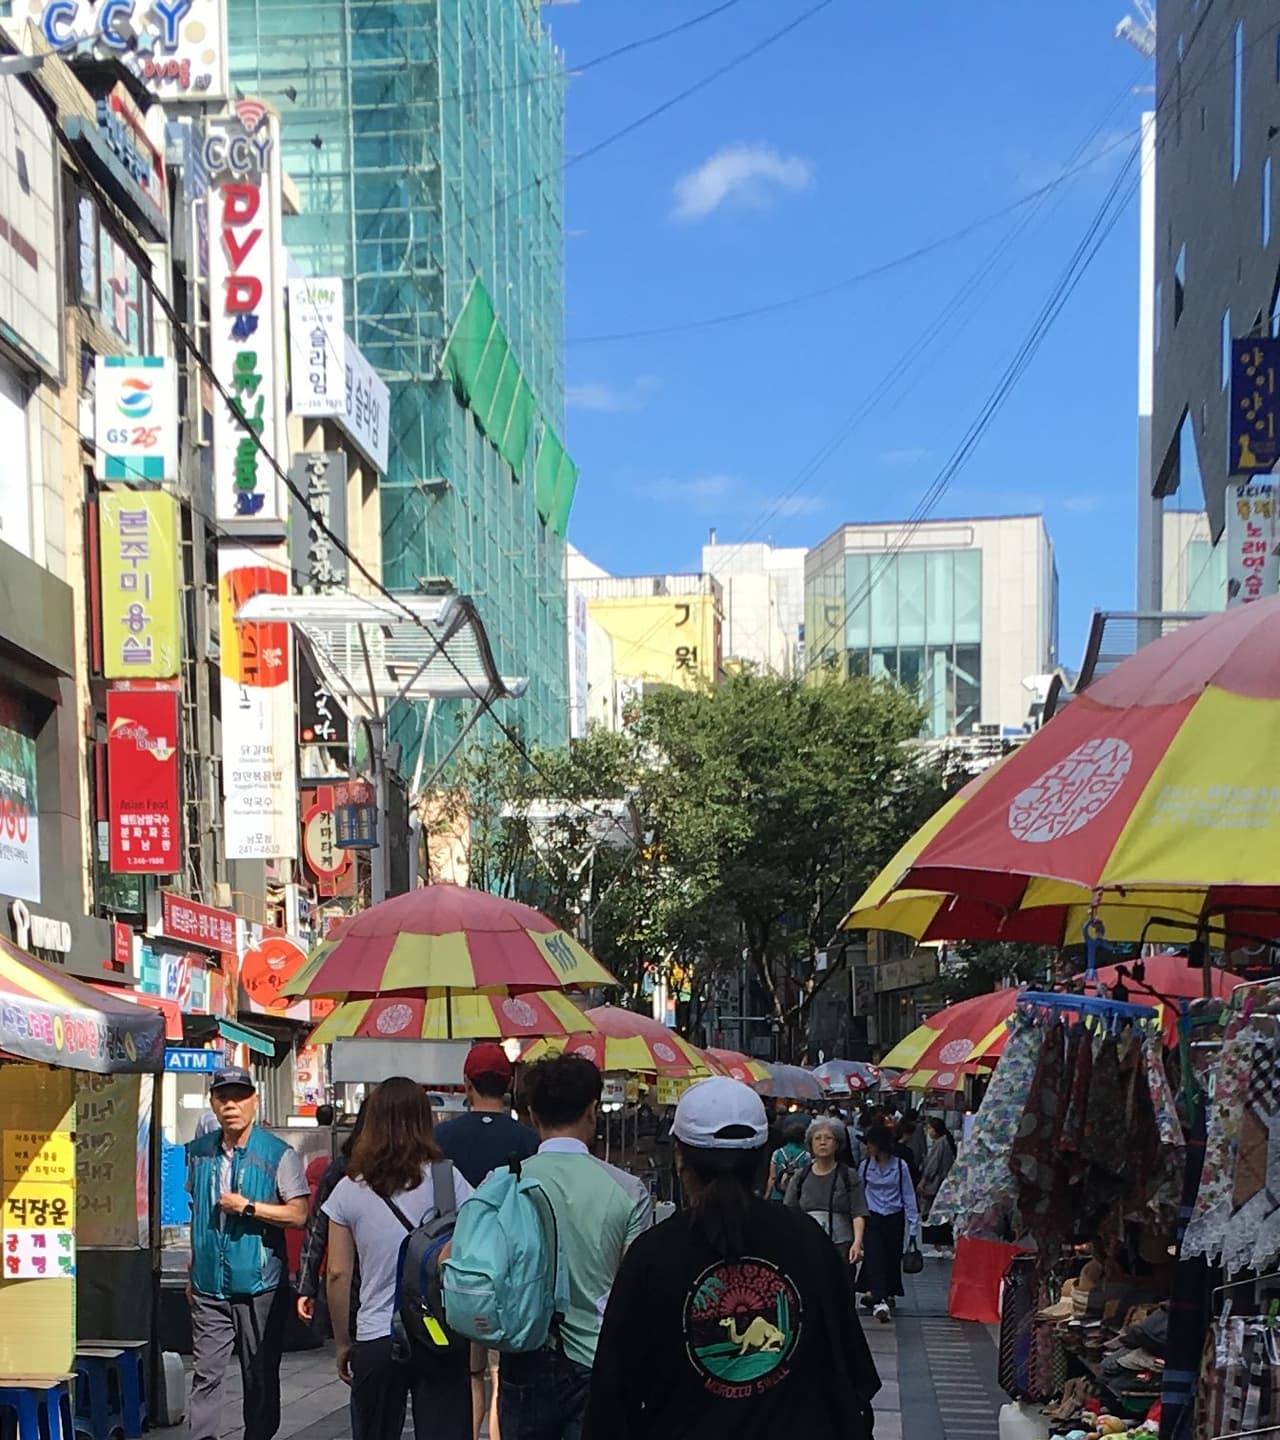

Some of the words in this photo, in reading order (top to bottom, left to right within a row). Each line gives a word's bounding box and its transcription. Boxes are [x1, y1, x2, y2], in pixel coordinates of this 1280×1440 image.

[42, 0, 193, 53] CCY
[204, 135, 273, 172] CCY
[221, 184, 263, 314] DVD
[309, 325, 328, 396] 슬라임
[106, 428, 129, 444] GS
[130, 425, 161, 449] 25
[118, 509, 153, 666] 본주미용실
[1241, 522, 1266, 603] 노래연습
[168, 1053, 208, 1069] ATM
[7, 1198, 69, 1227] 직장운
